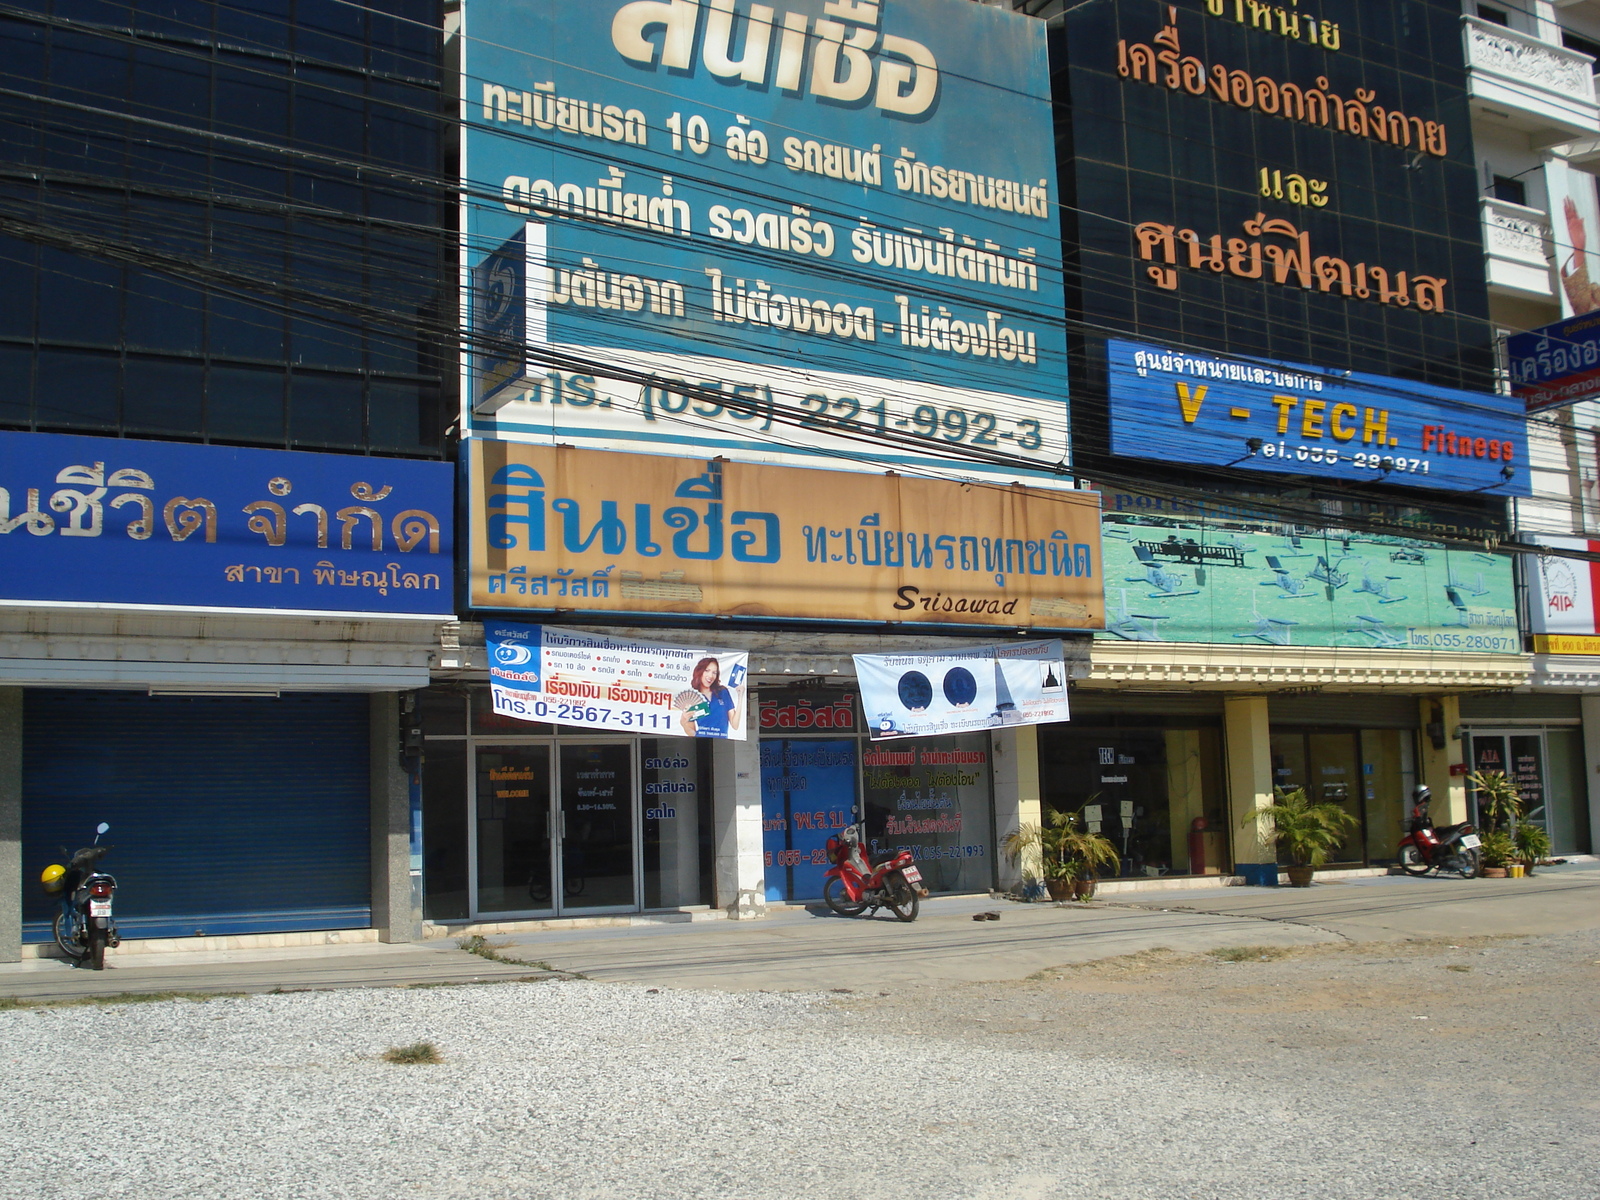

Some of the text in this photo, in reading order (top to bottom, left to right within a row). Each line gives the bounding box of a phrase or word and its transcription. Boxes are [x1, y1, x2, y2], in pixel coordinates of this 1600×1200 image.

[1116, 5, 1447, 156] เครื่องออกกำลังกาย
[482, 80, 1050, 219] ทะเบียนรถ 10 ล้อ รถยนต์ จักรยานยนต์
[1259, 166, 1330, 208] และ
[502, 165, 1040, 292] ดอกเบี้ยต่ำ รวดเร็ว รับเงินได้ทันที
[1134, 212, 1448, 314] ศูนย์ฟิตเนส
[895, 295, 1038, 364] ไม่ต้องโอน
[1134, 350, 1323, 393] ศูนย์จำหน่ายและบรการ
[642, 368, 774, 430] (055)
[799, 393, 1042, 450] 221-992-3
[1176, 382, 1209, 424] V
[1271, 395, 1399, 447] TECH.
[1421, 424, 1515, 462] Fitness
[242, 476, 440, 555] จำกัด
[488, 461, 782, 564] สินเชื่อ
[224, 560, 441, 597] สาขา พิษณุโลก
[488, 564, 617, 598] ศรีสวัสดิ์
[802, 512, 1092, 587] ทะเบียนรถทุกชนิด
[893, 585, 1019, 616] Srisawad
[1549, 594, 1574, 612] AIA
[545, 672, 672, 711] เรื่องเงิน เรื่องง่ายๆ
[565, 662, 575, 670] 10
[778, 849, 833, 868] 055-22
